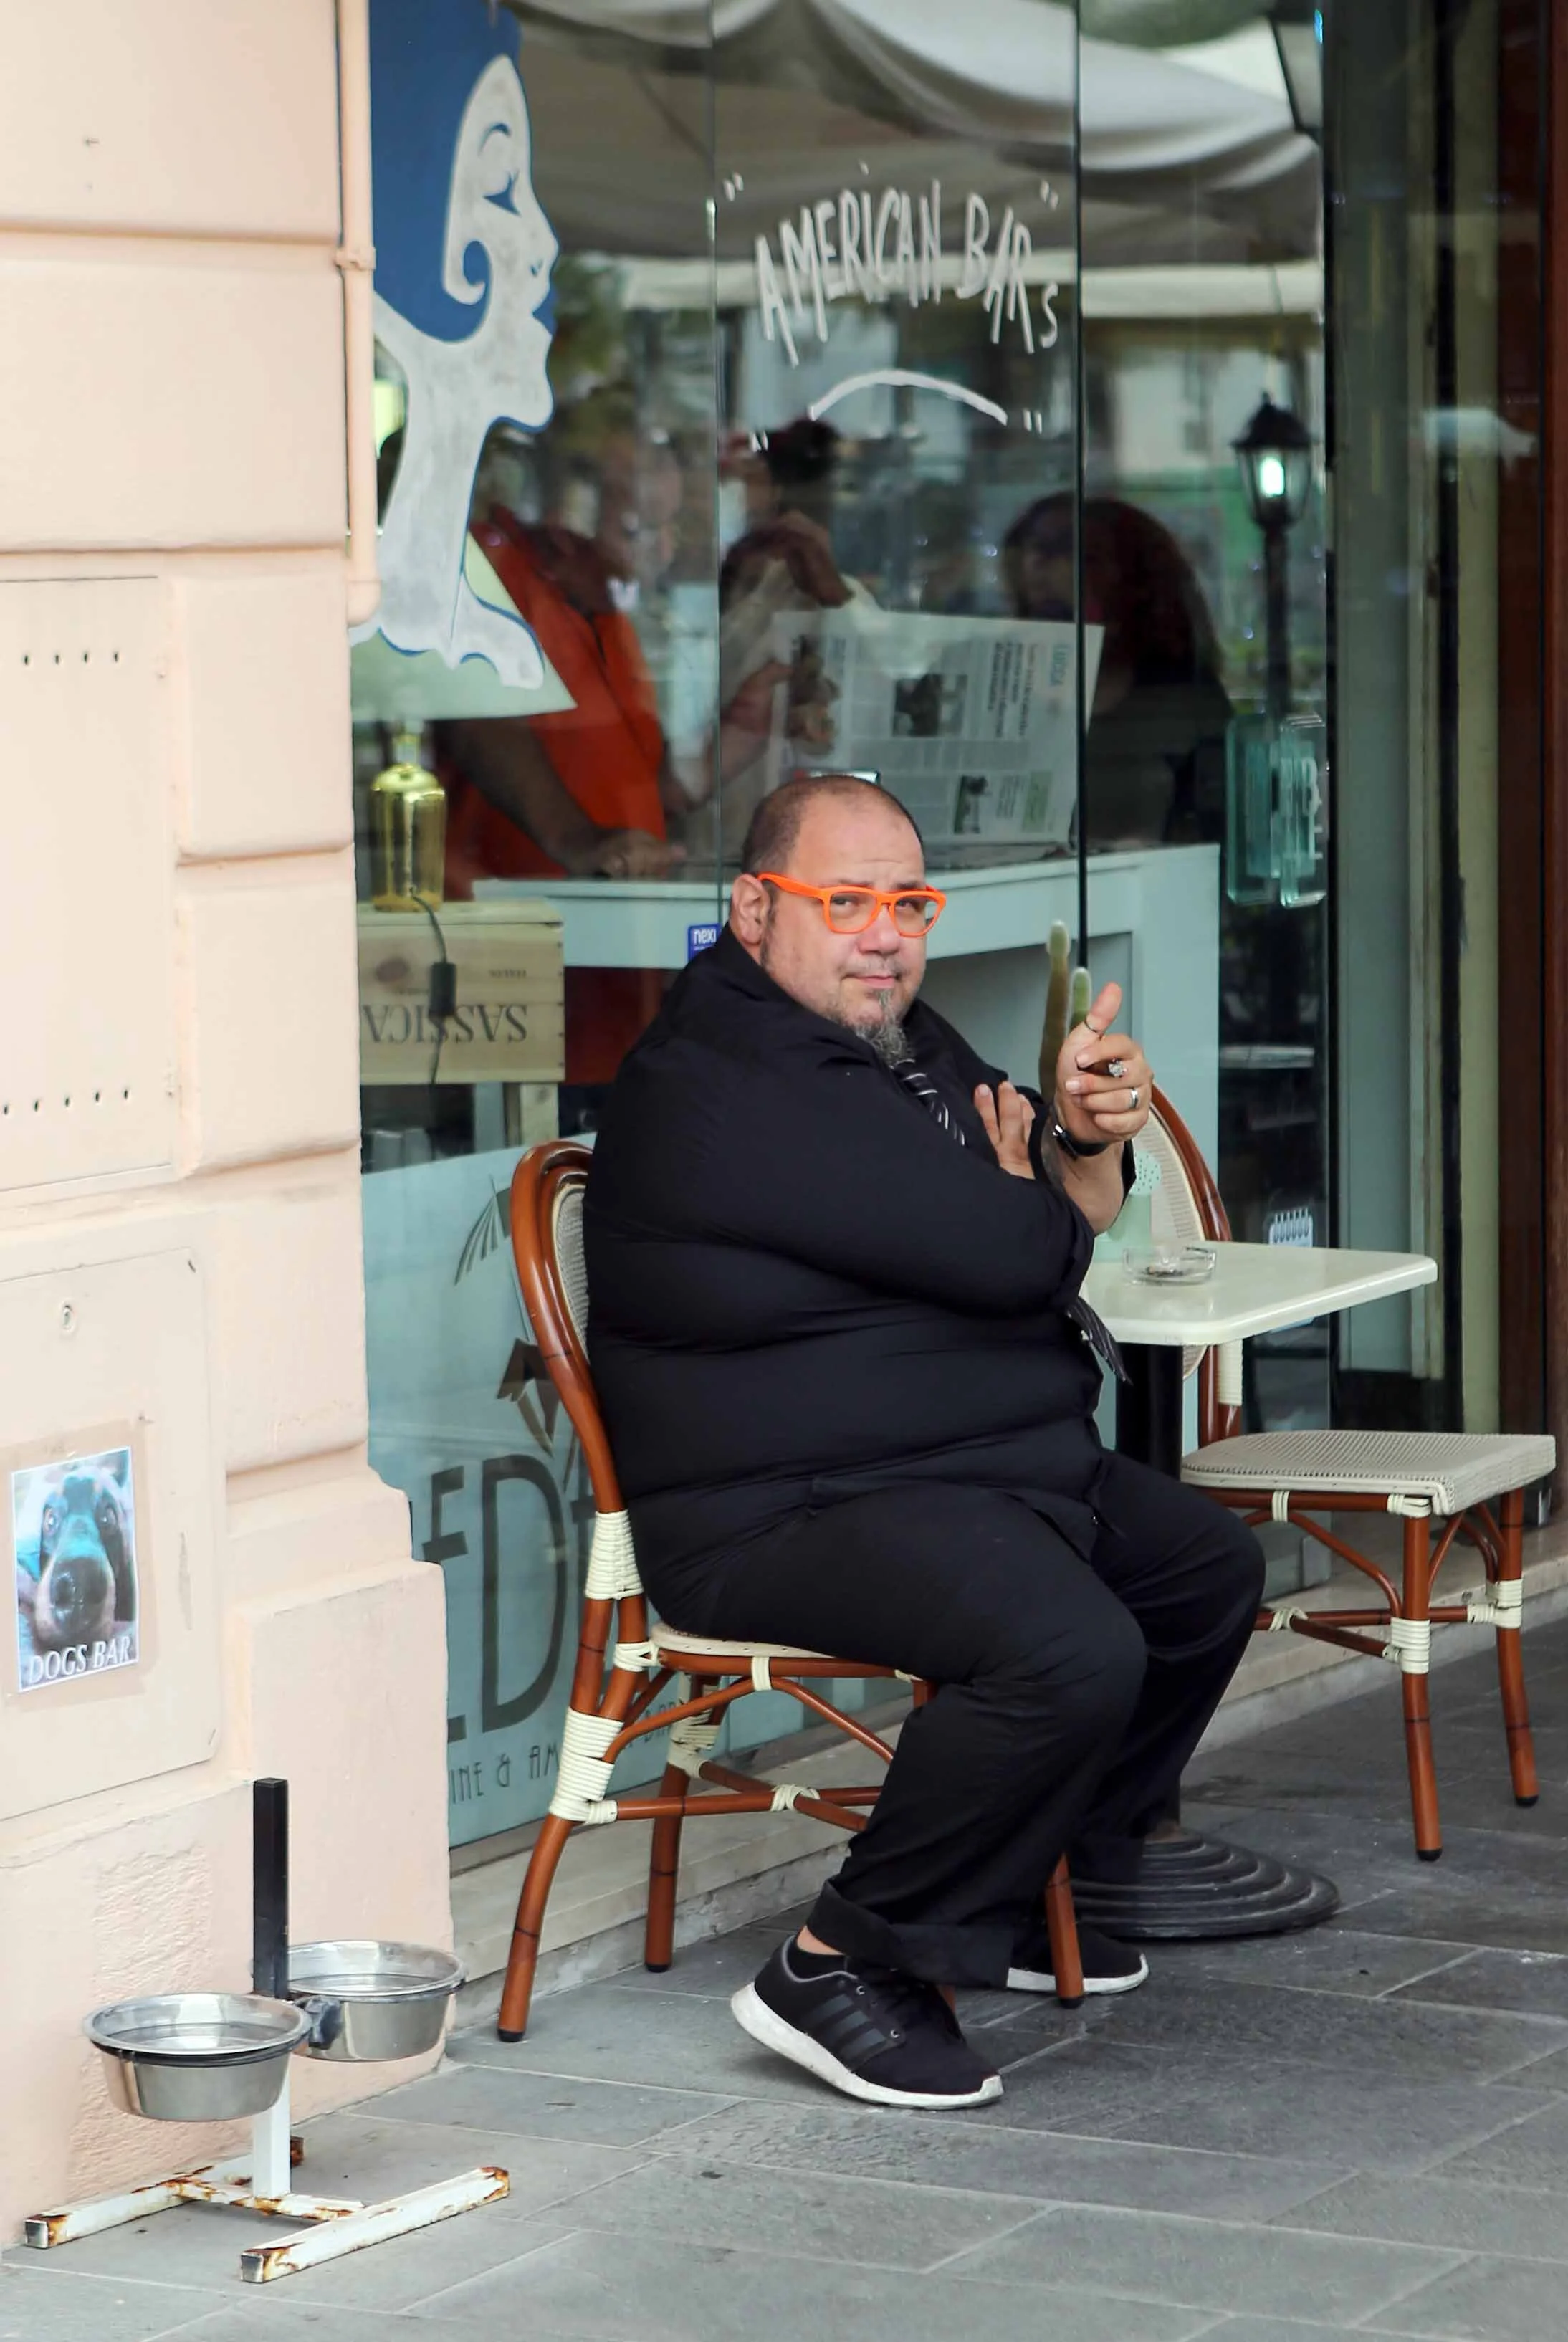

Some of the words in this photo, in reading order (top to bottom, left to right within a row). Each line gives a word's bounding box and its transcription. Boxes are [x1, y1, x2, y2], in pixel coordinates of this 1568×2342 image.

[756, 163, 941, 367] AMERICAN
[29, 1644, 87, 1684] DOGS
[93, 1635, 131, 1668] BAR
[529, 1742, 560, 1779] AM
